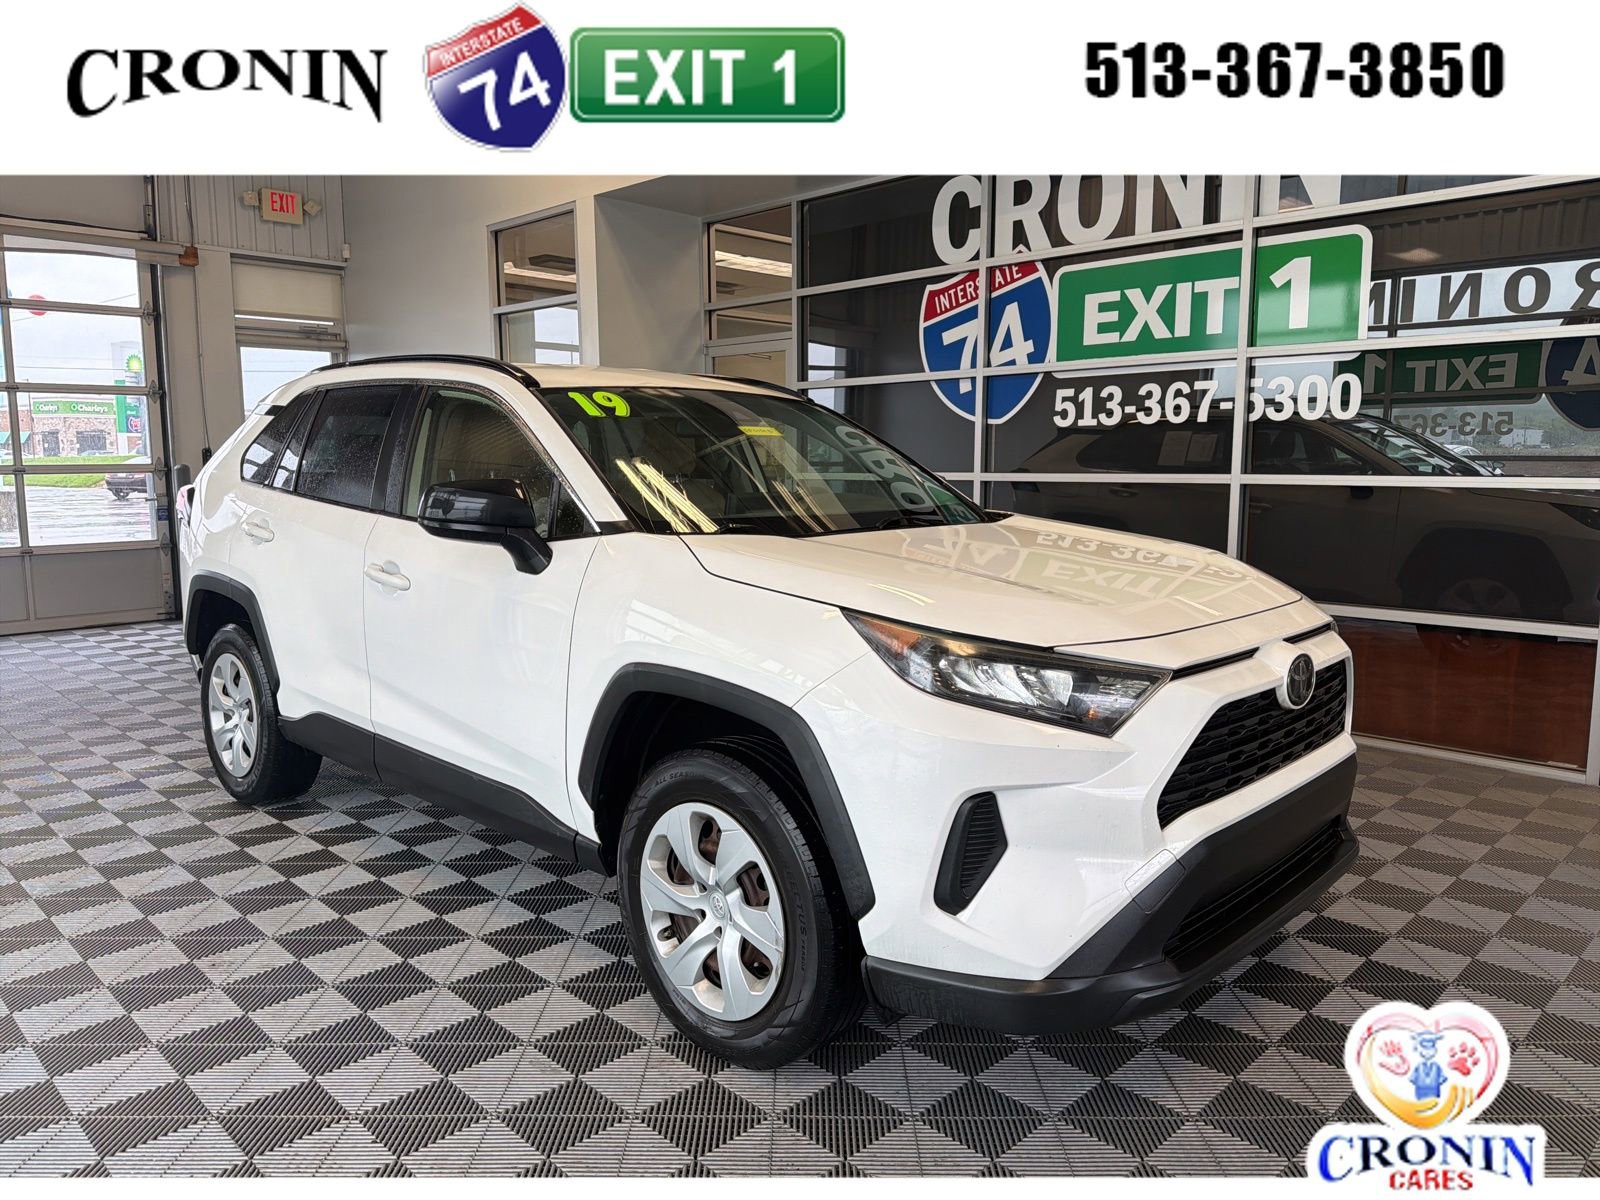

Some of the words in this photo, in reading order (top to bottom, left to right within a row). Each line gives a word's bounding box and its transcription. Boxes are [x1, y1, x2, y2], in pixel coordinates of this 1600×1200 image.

[270, 191, 296, 216] EXIT
[934, 263, 1023, 314] INTERSATE
[1082, 276, 1241, 346] EXIT
[1269, 256, 1312, 329] 1
[941, 301, 1034, 395] 74
[567, 391, 631, 417] 19
[1053, 373, 1362, 427] 513-367-5300
